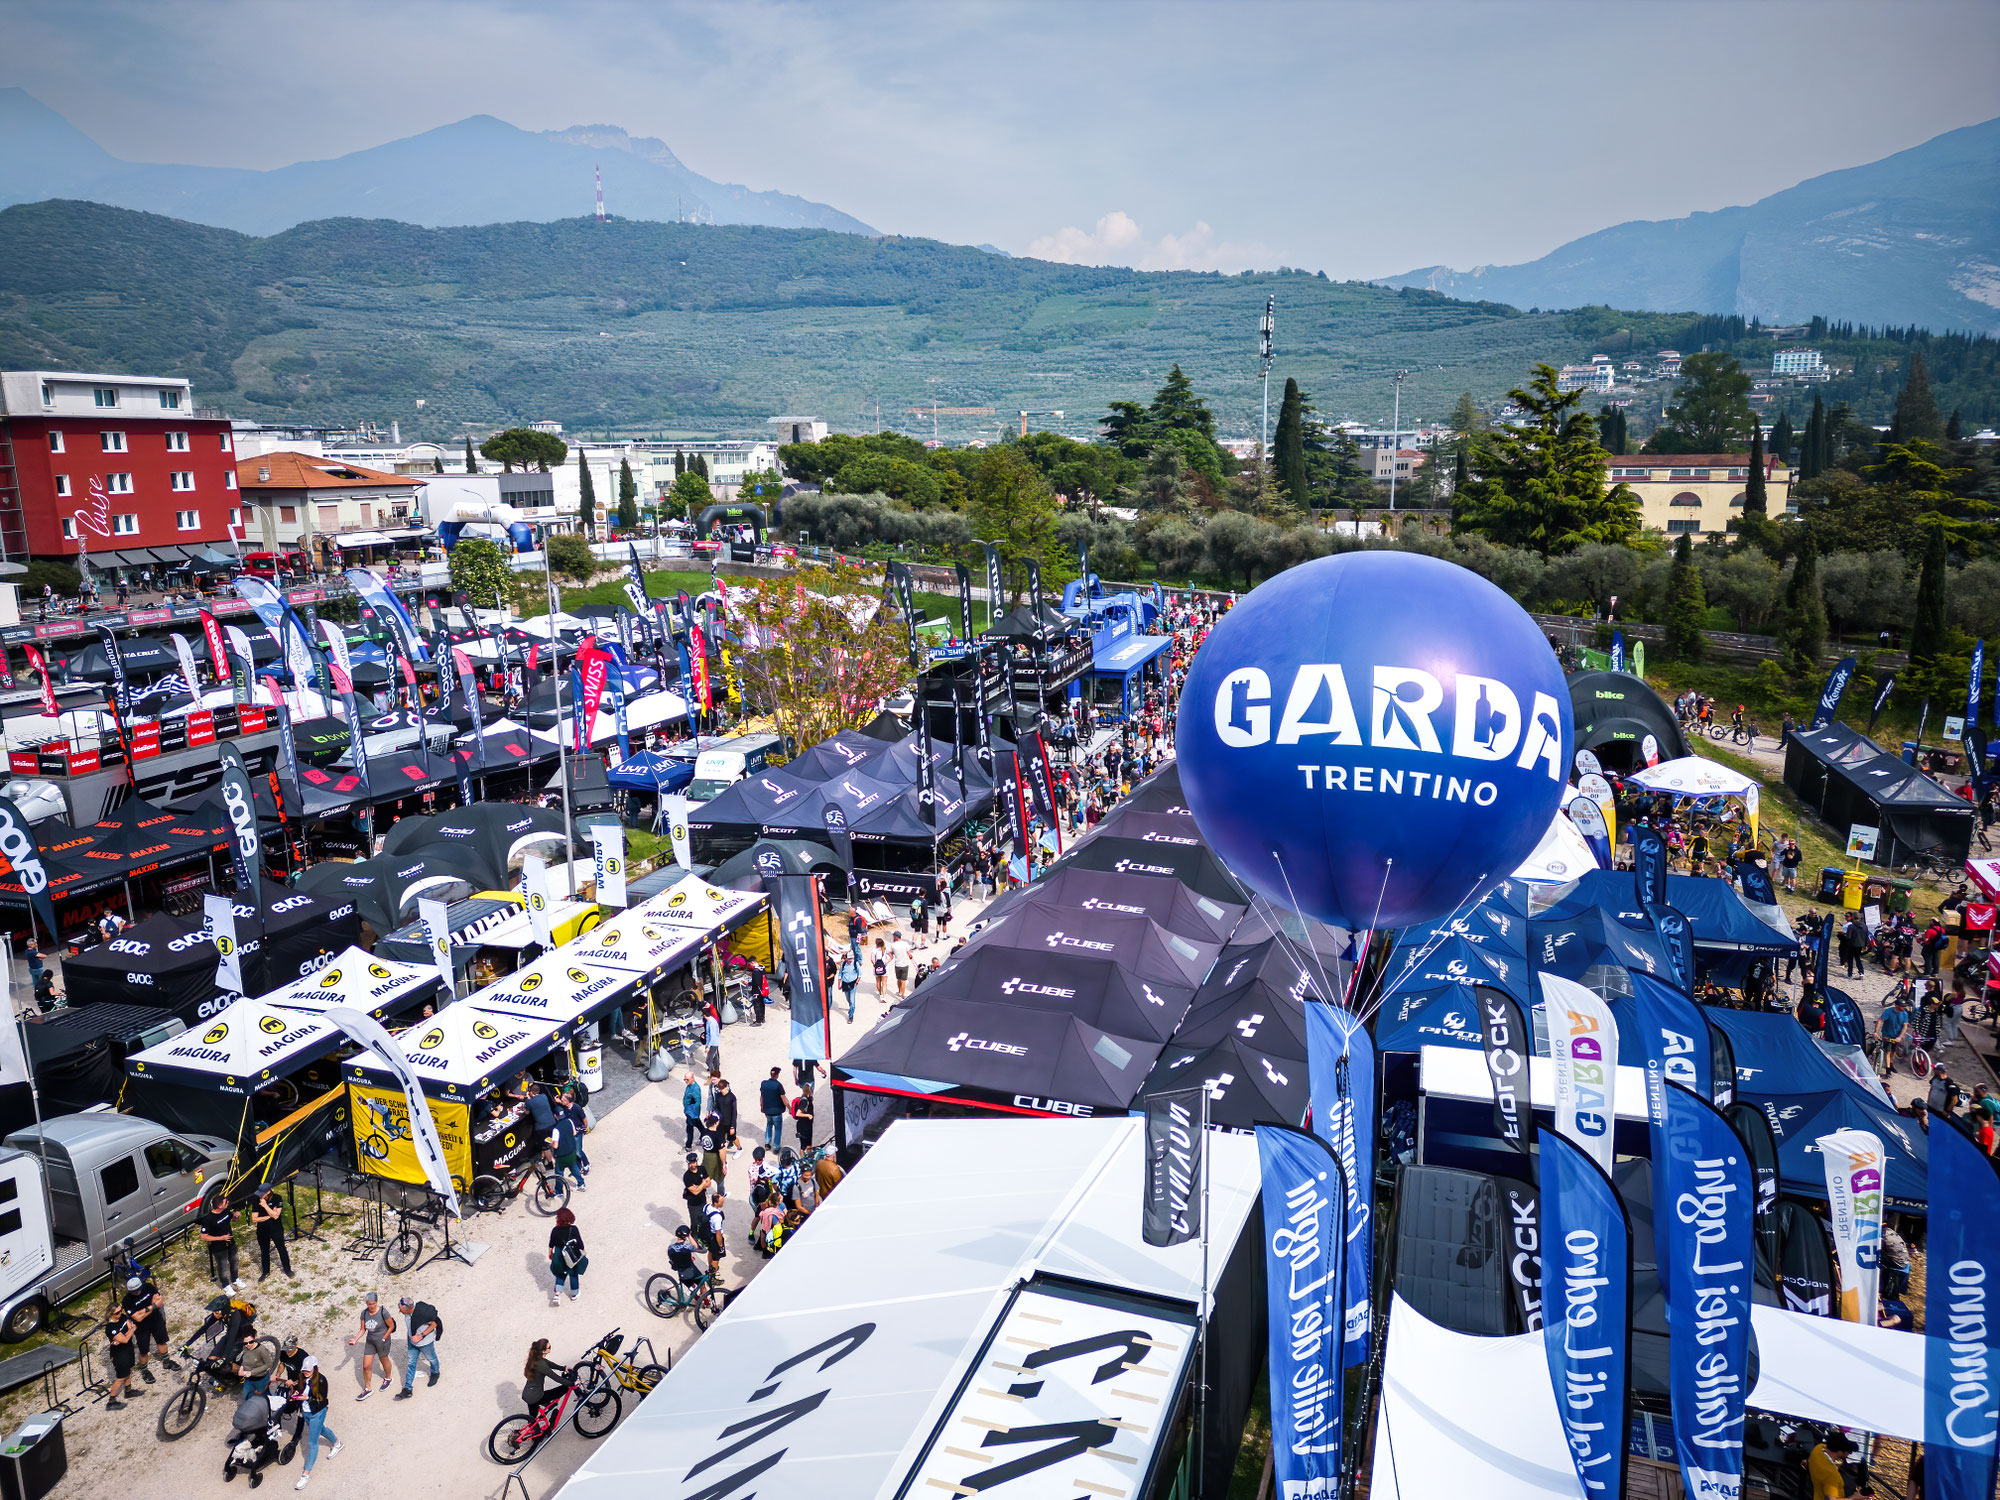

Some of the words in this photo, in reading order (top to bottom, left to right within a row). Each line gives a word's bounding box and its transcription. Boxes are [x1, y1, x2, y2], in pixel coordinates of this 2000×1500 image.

[1595, 690, 1625, 700] bike
[1214, 663, 1563, 783] GARDA
[847, 751, 867, 765] SCOTT
[1036, 775, 1052, 811] CUBE
[1297, 764, 1499, 807] TRENTINO
[774, 789, 799, 804] SCOTT
[857, 792, 880, 809] SCOTT
[943, 798, 964, 816] SCOTT
[1007, 792, 1019, 838] CUBE
[138, 815, 176, 828] MAXXIS
[52, 836, 94, 852] MAXXIS
[1165, 836, 1199, 846] CUBE
[130, 843, 171, 859] MAXXIS
[128, 862, 159, 877] MAXXIS
[1144, 864, 1175, 875] CUBE
[272, 896, 311, 913] evoc
[712, 897, 745, 915] MAGURA
[1097, 902, 1146, 914] CUBE
[329, 905, 352, 921] evoc
[644, 909, 693, 920] MAGURA
[109, 939, 148, 955] evoc
[648, 935, 685, 957] MAGURA
[1061, 936, 1115, 951] CUBE
[1545, 933, 1557, 963] PIVOT
[576, 950, 628, 961] MAGURA
[795, 933, 814, 993] CUBE
[127, 973, 153, 985] evoc
[370, 973, 421, 998] MAGURA
[1424, 973, 1489, 985] PIVOT
[288, 990, 346, 1003] MAGURA
[571, 976, 617, 1003] MAGURA
[1018, 983, 1076, 998] CUBE
[490, 992, 549, 1008] MAGURA
[258, 1023, 322, 1057] MAGURA
[475, 1030, 530, 1063] MAGURA
[965, 1040, 1028, 1056] CUBE
[168, 1046, 231, 1064] MAGURA
[254, 1074, 279, 1091] MAGURA
[347, 1076, 372, 1085] MAGURA
[219, 1085, 244, 1094] MAGURA
[440, 1093, 465, 1102] MAGURA
[474, 1082, 496, 1099] MAGURA
[1013, 1094, 1094, 1118] CUBE
[1763, 1101, 1784, 1136] PIVOT
[493, 1140, 527, 1167] MAGURA
